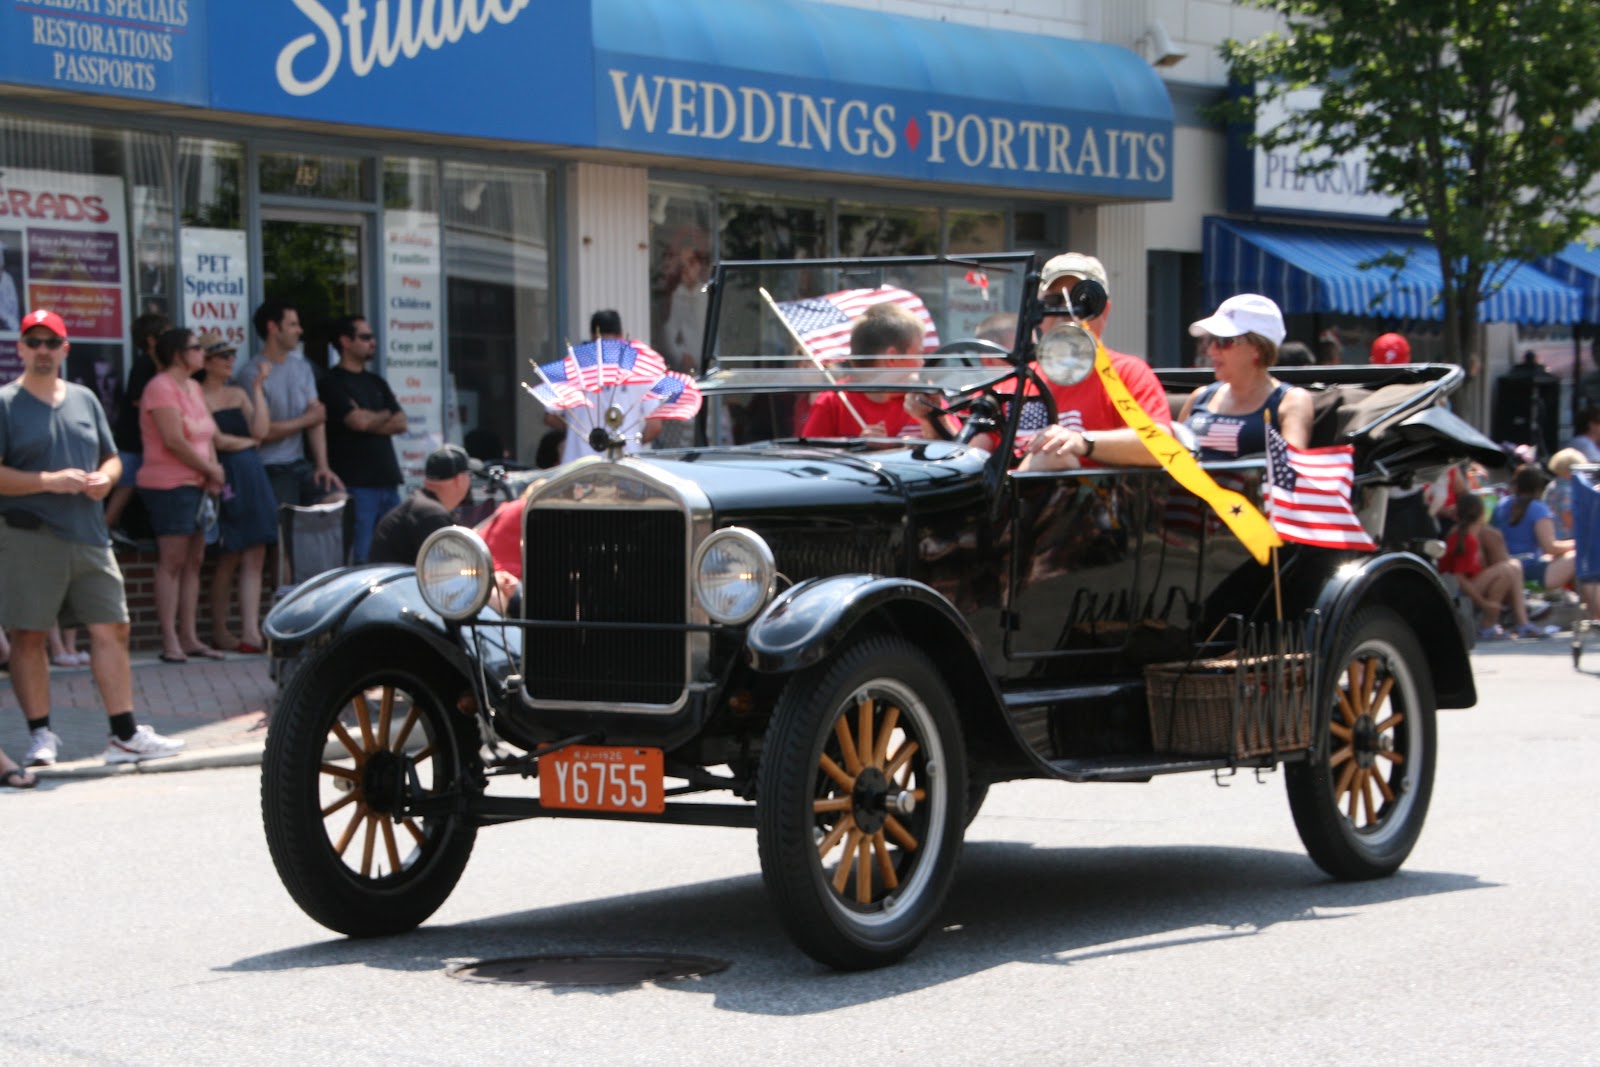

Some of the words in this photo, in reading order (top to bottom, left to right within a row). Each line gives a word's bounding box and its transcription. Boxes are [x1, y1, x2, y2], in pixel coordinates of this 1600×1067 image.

[32, 16, 173, 62] RESTORATIONS
[53, 52, 156, 91] PASSPORTS
[609, 69, 896, 158] WEDDINGS
[927, 109, 1166, 183] PORTRAITS
[1263, 152, 1392, 199] PHARM
[197, 253, 232, 273] PET
[185, 274, 244, 297] Special
[391, 298, 431, 310] Children
[192, 301, 240, 320] ONLY
[554, 761, 647, 807] Y6755
